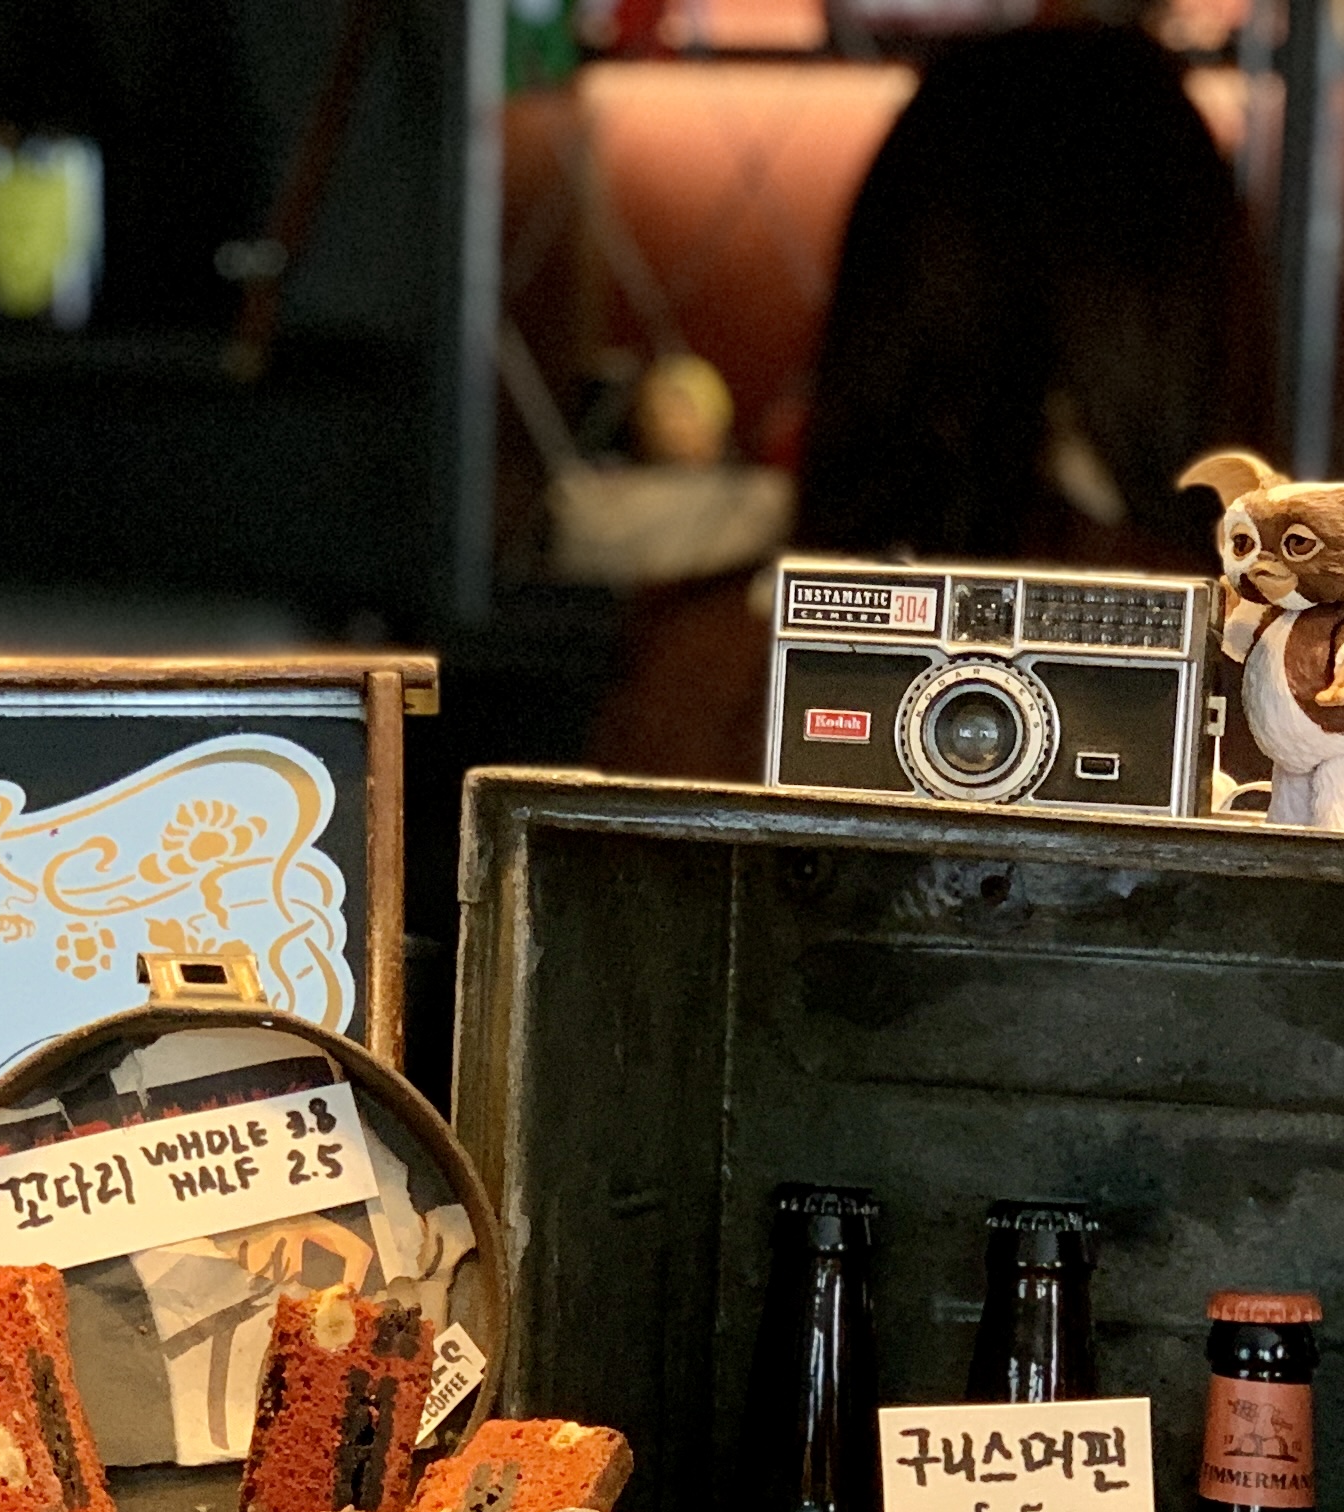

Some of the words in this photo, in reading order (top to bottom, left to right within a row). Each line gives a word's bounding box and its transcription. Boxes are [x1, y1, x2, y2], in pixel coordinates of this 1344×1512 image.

[796, 587, 889, 607] INSTAMATIC
[894, 595, 928, 623] 304
[800, 610, 882, 623] CAMERA
[815, 714, 861, 731] Kodak
[915, 668, 981, 718] KODAR
[1005, 676, 1040, 729] LENS
[142, 1119, 269, 1168] WHOLE
[285, 1097, 338, 1140] 3.8
[172, 1155, 260, 1201] HALF
[288, 1142, 344, 1184] 2.5
[896, 1426, 1131, 1494] 구니스머핀
